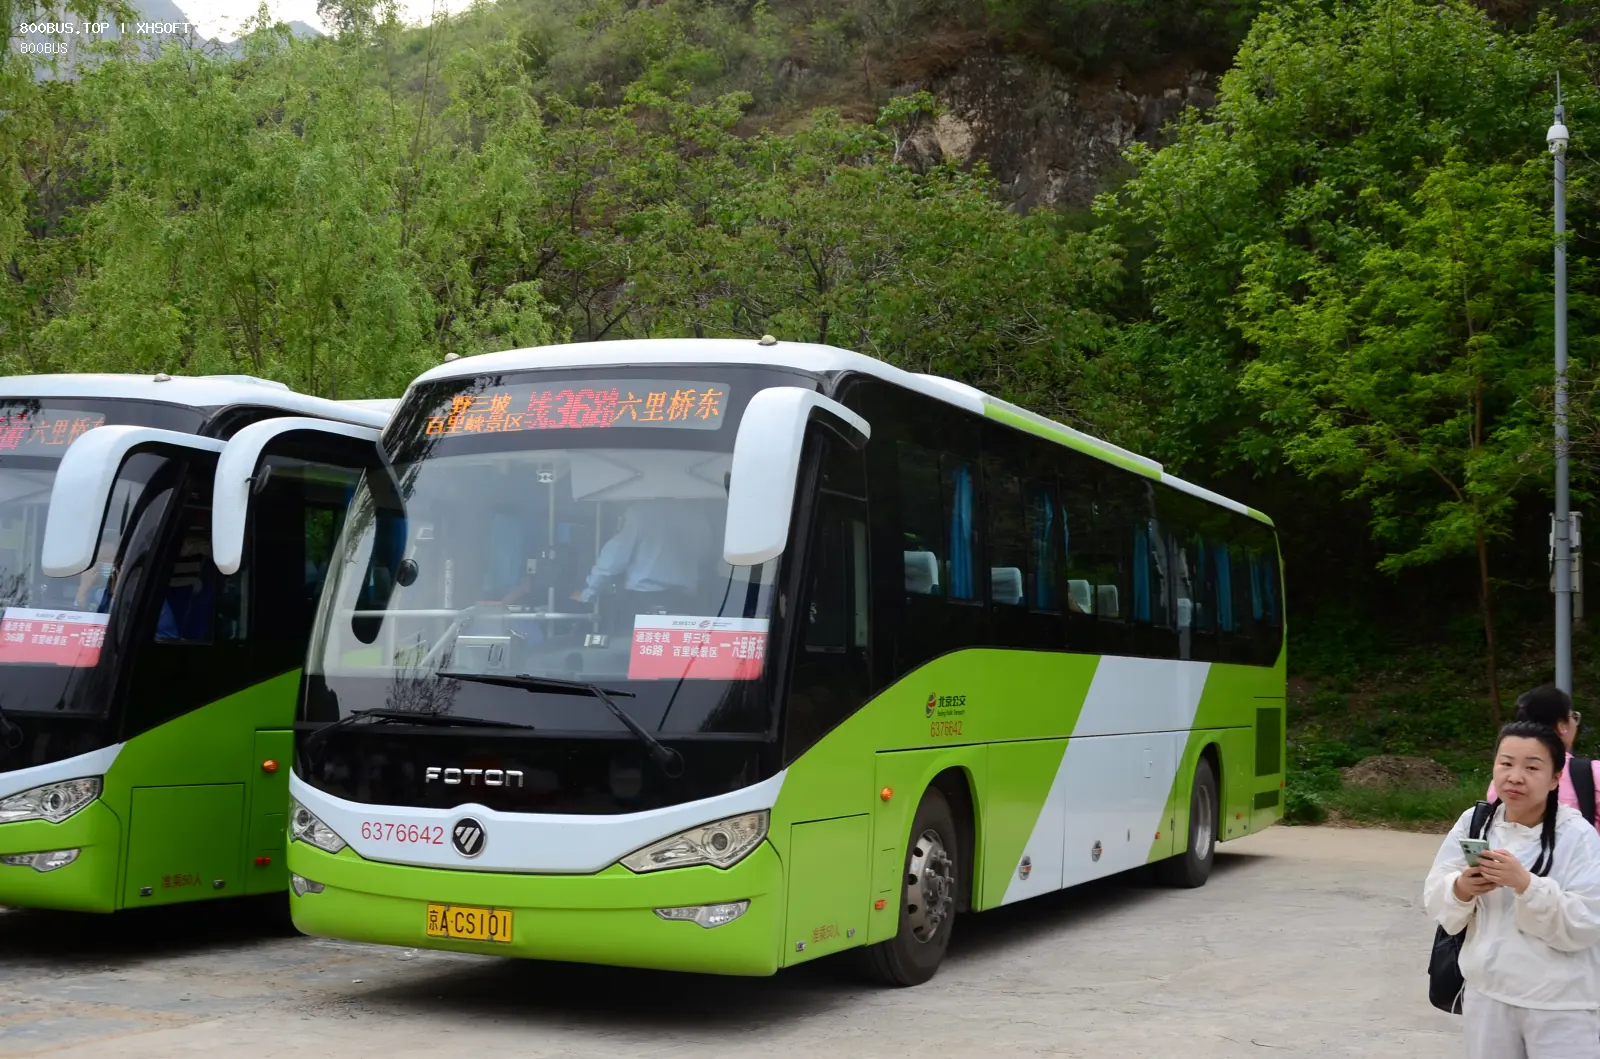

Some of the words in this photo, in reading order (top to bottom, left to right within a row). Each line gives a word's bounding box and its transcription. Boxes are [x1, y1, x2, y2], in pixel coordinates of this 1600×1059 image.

[449, 392, 512, 416] 野三坡
[611, 387, 722, 421] 六里桥东
[425, 412, 525, 435] 百里峡景区
[639, 644, 664, 657] 36路
[672, 646, 718, 658] 百里峡景区
[938, 695, 966, 708] 北京公交
[930, 720, 963, 738] 6376642
[425, 767, 524, 788] FOTON
[361, 821, 444, 845] 6376642
